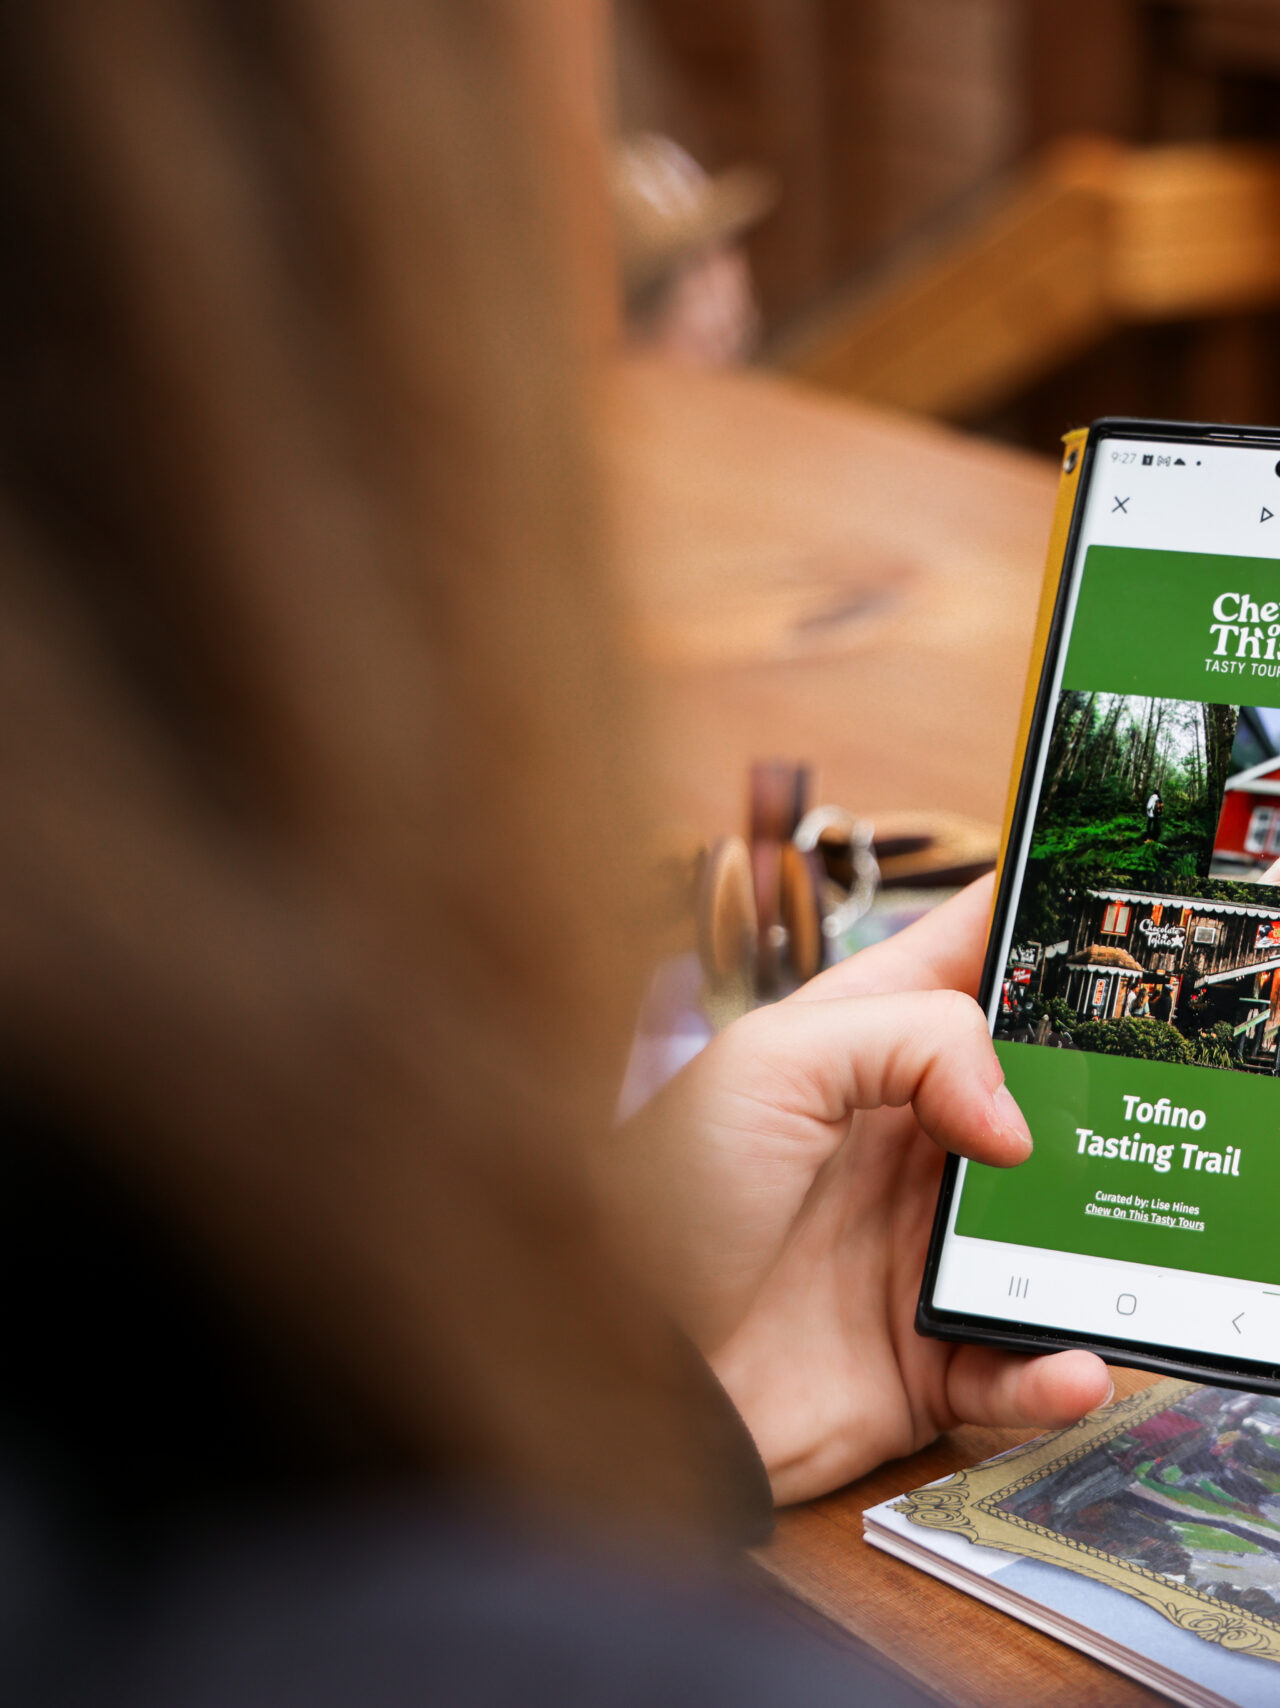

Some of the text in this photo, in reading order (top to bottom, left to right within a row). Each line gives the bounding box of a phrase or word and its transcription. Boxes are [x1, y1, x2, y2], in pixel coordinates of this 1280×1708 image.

[1111, 452, 1137, 464] 9:27
[1205, 658, 1246, 675] TASTY
[1122, 1094, 1207, 1131] Tofino
[1075, 1127, 1242, 1177] Tasting Trail
[1095, 1190, 1200, 1216] Curated by: Lise Hines
[1085, 1203, 1205, 1231] Chew On This Tasty Tours
